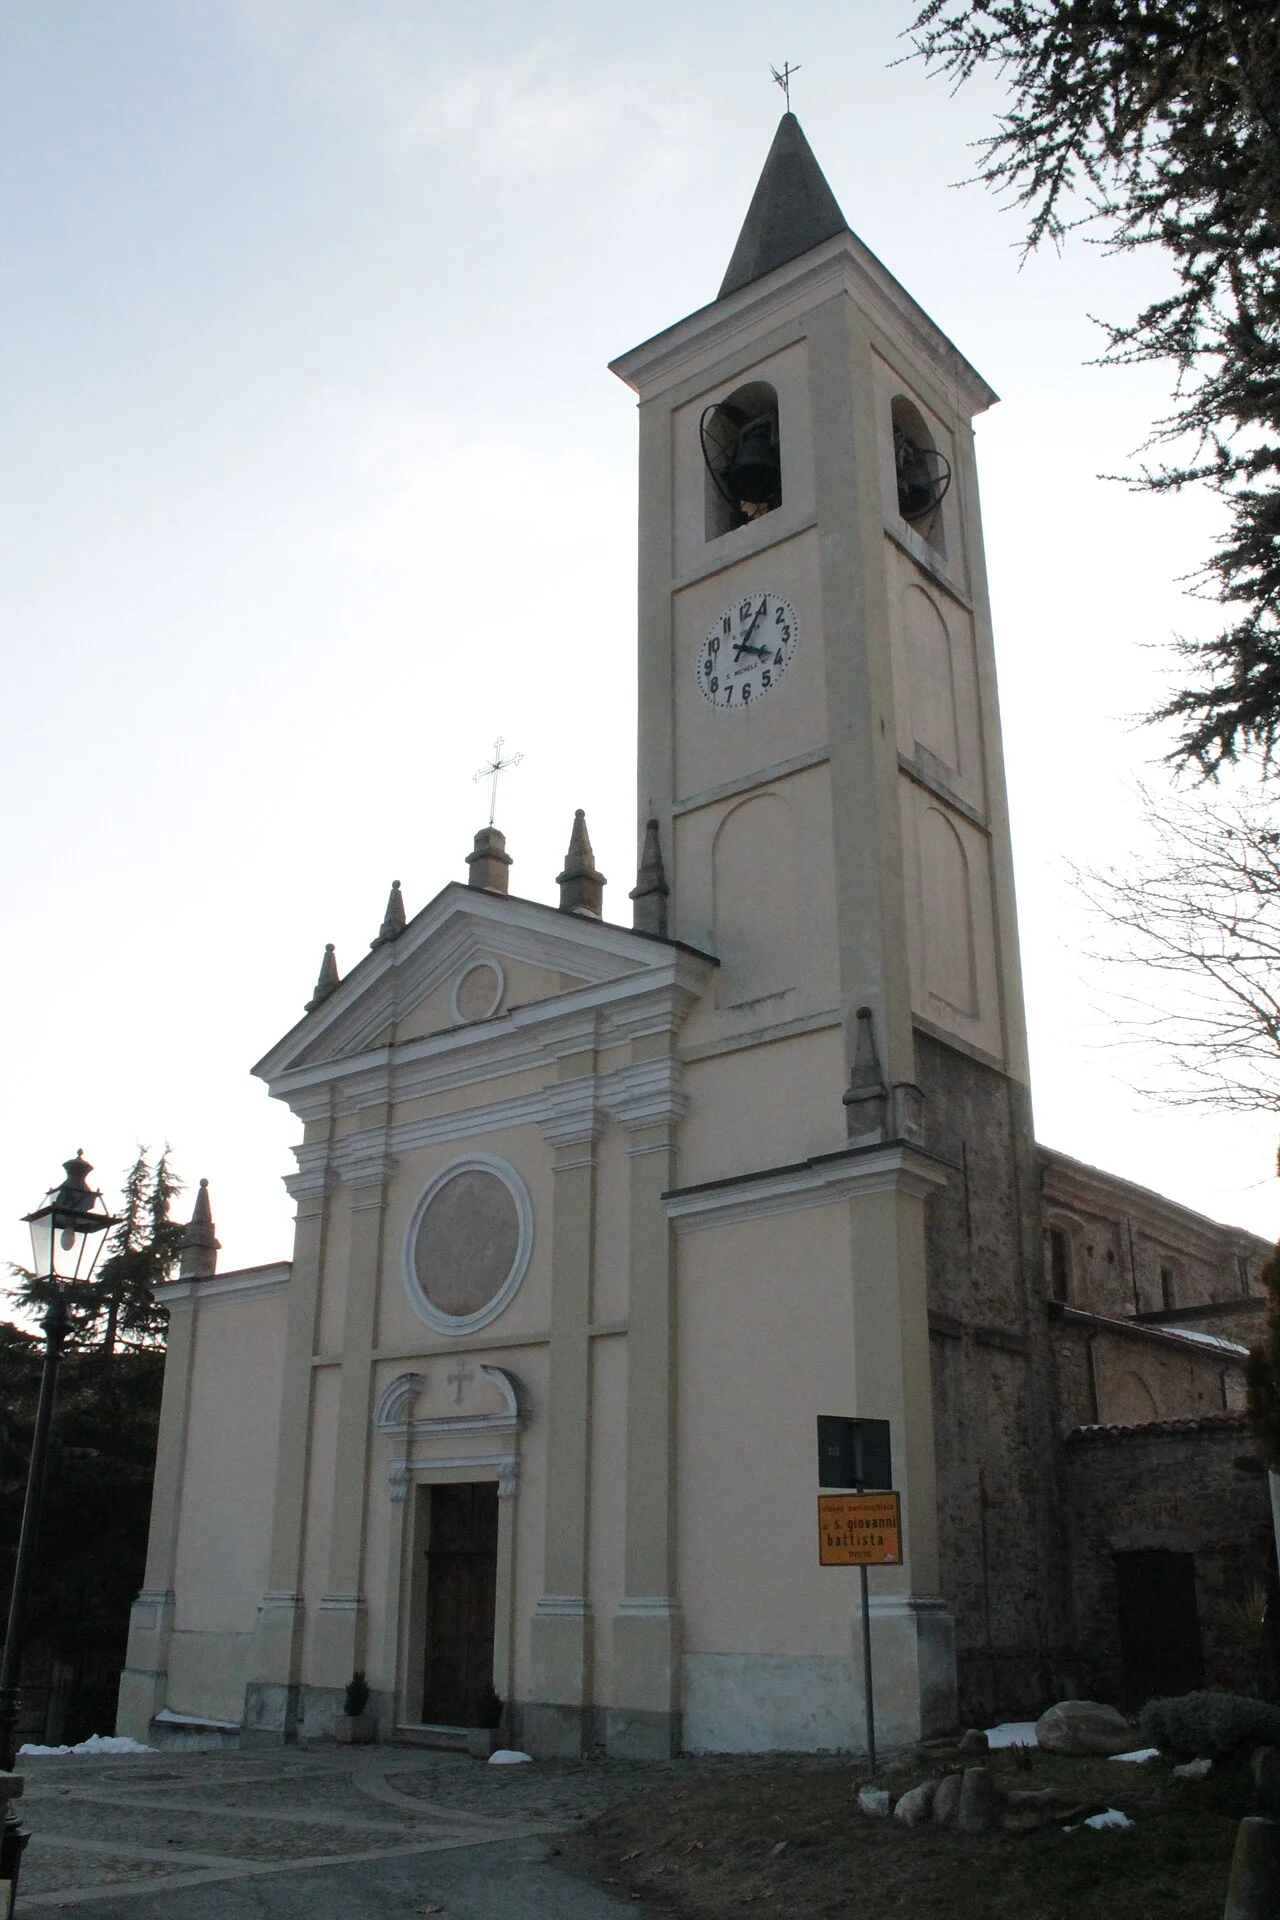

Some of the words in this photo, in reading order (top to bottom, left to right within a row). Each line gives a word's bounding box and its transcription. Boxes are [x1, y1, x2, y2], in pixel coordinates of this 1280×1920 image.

[739, 602, 752, 621] 12
[775, 607, 785, 624] 2
[723, 616, 731, 634] 11
[781, 625, 791, 643] 3
[708, 637, 720, 656] 10
[773, 647, 783, 665] 4
[704, 659, 713, 676] 9
[710, 676, 719, 693] 8
[761, 669, 770, 688] 5
[724, 685, 733, 703] 7
[742, 683, 751, 700] 6
[847, 1516, 896, 1532] giovanni
[827, 1533, 884, 1546] battista
